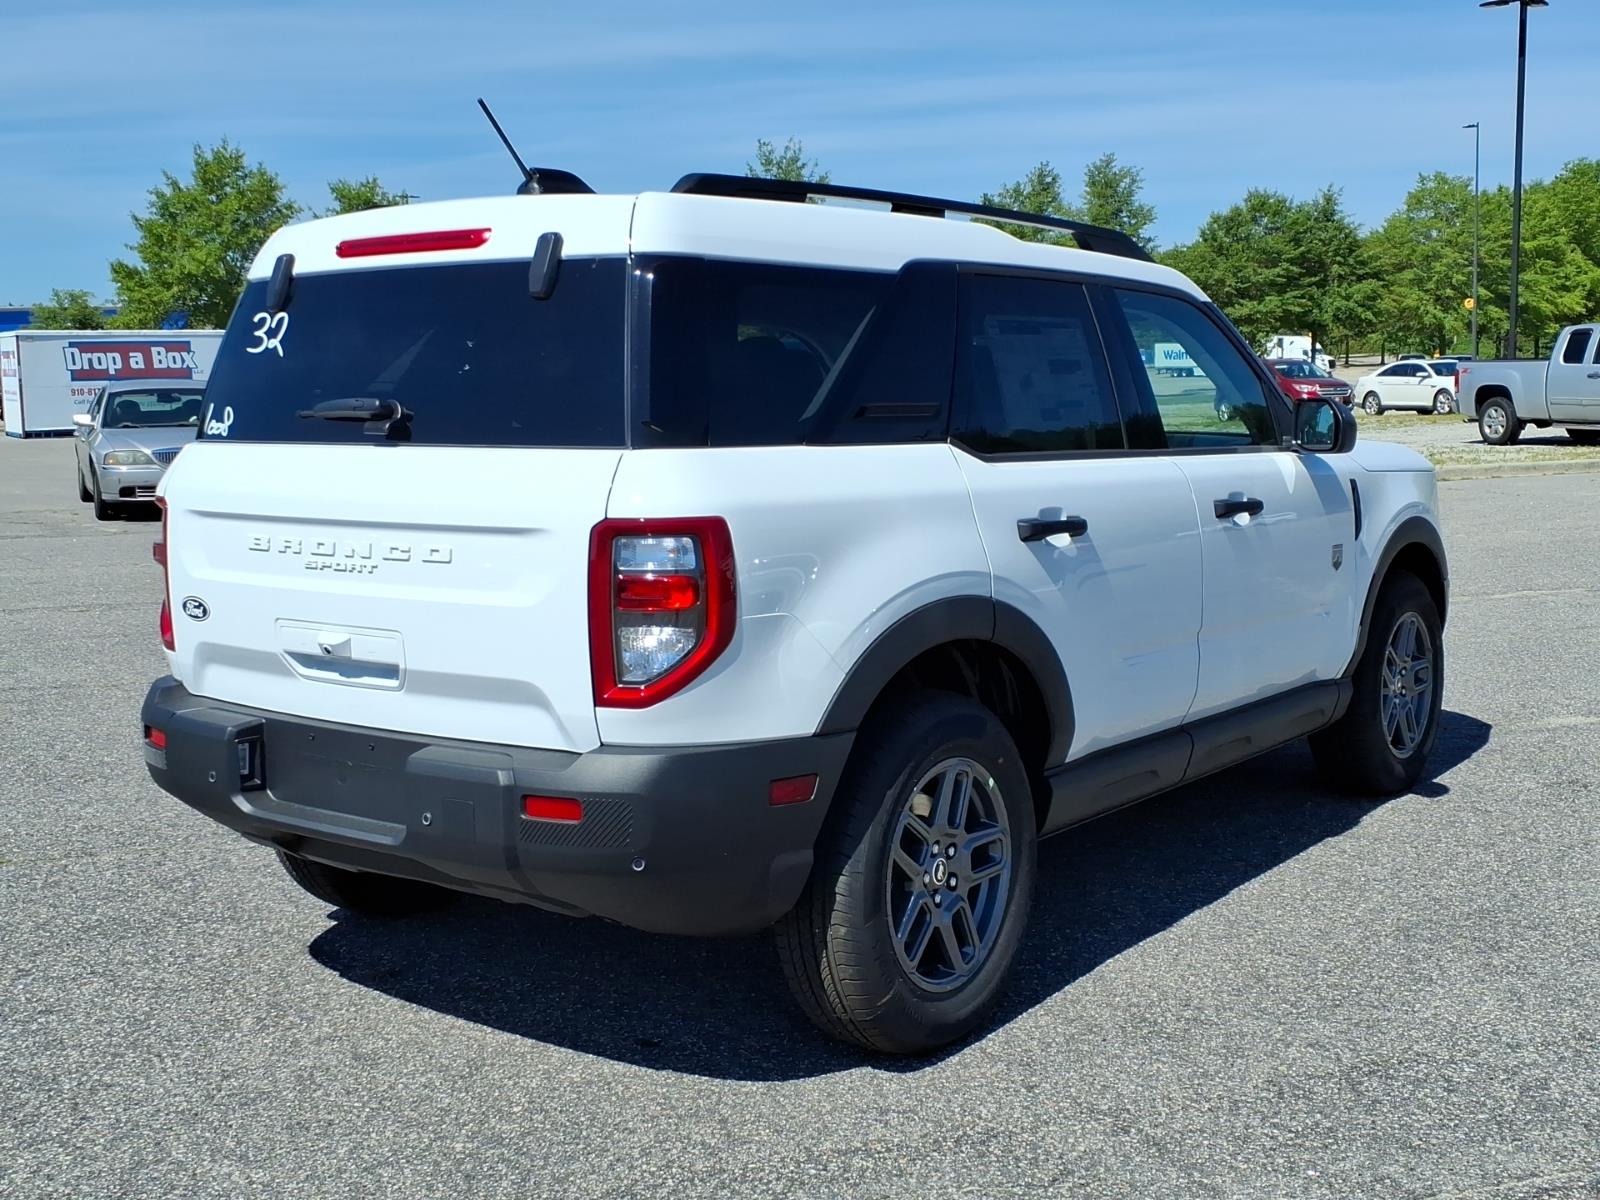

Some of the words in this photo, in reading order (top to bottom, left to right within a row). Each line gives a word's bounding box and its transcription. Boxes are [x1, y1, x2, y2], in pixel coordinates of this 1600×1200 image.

[246, 311, 288, 357] 32
[63, 346, 123, 375] Drop
[128, 351, 145, 369] a
[150, 346, 198, 369] Box
[248, 535, 453, 564] BRONCO
[304, 559, 378, 575] SPORT
[185, 600, 204, 617] Ford
